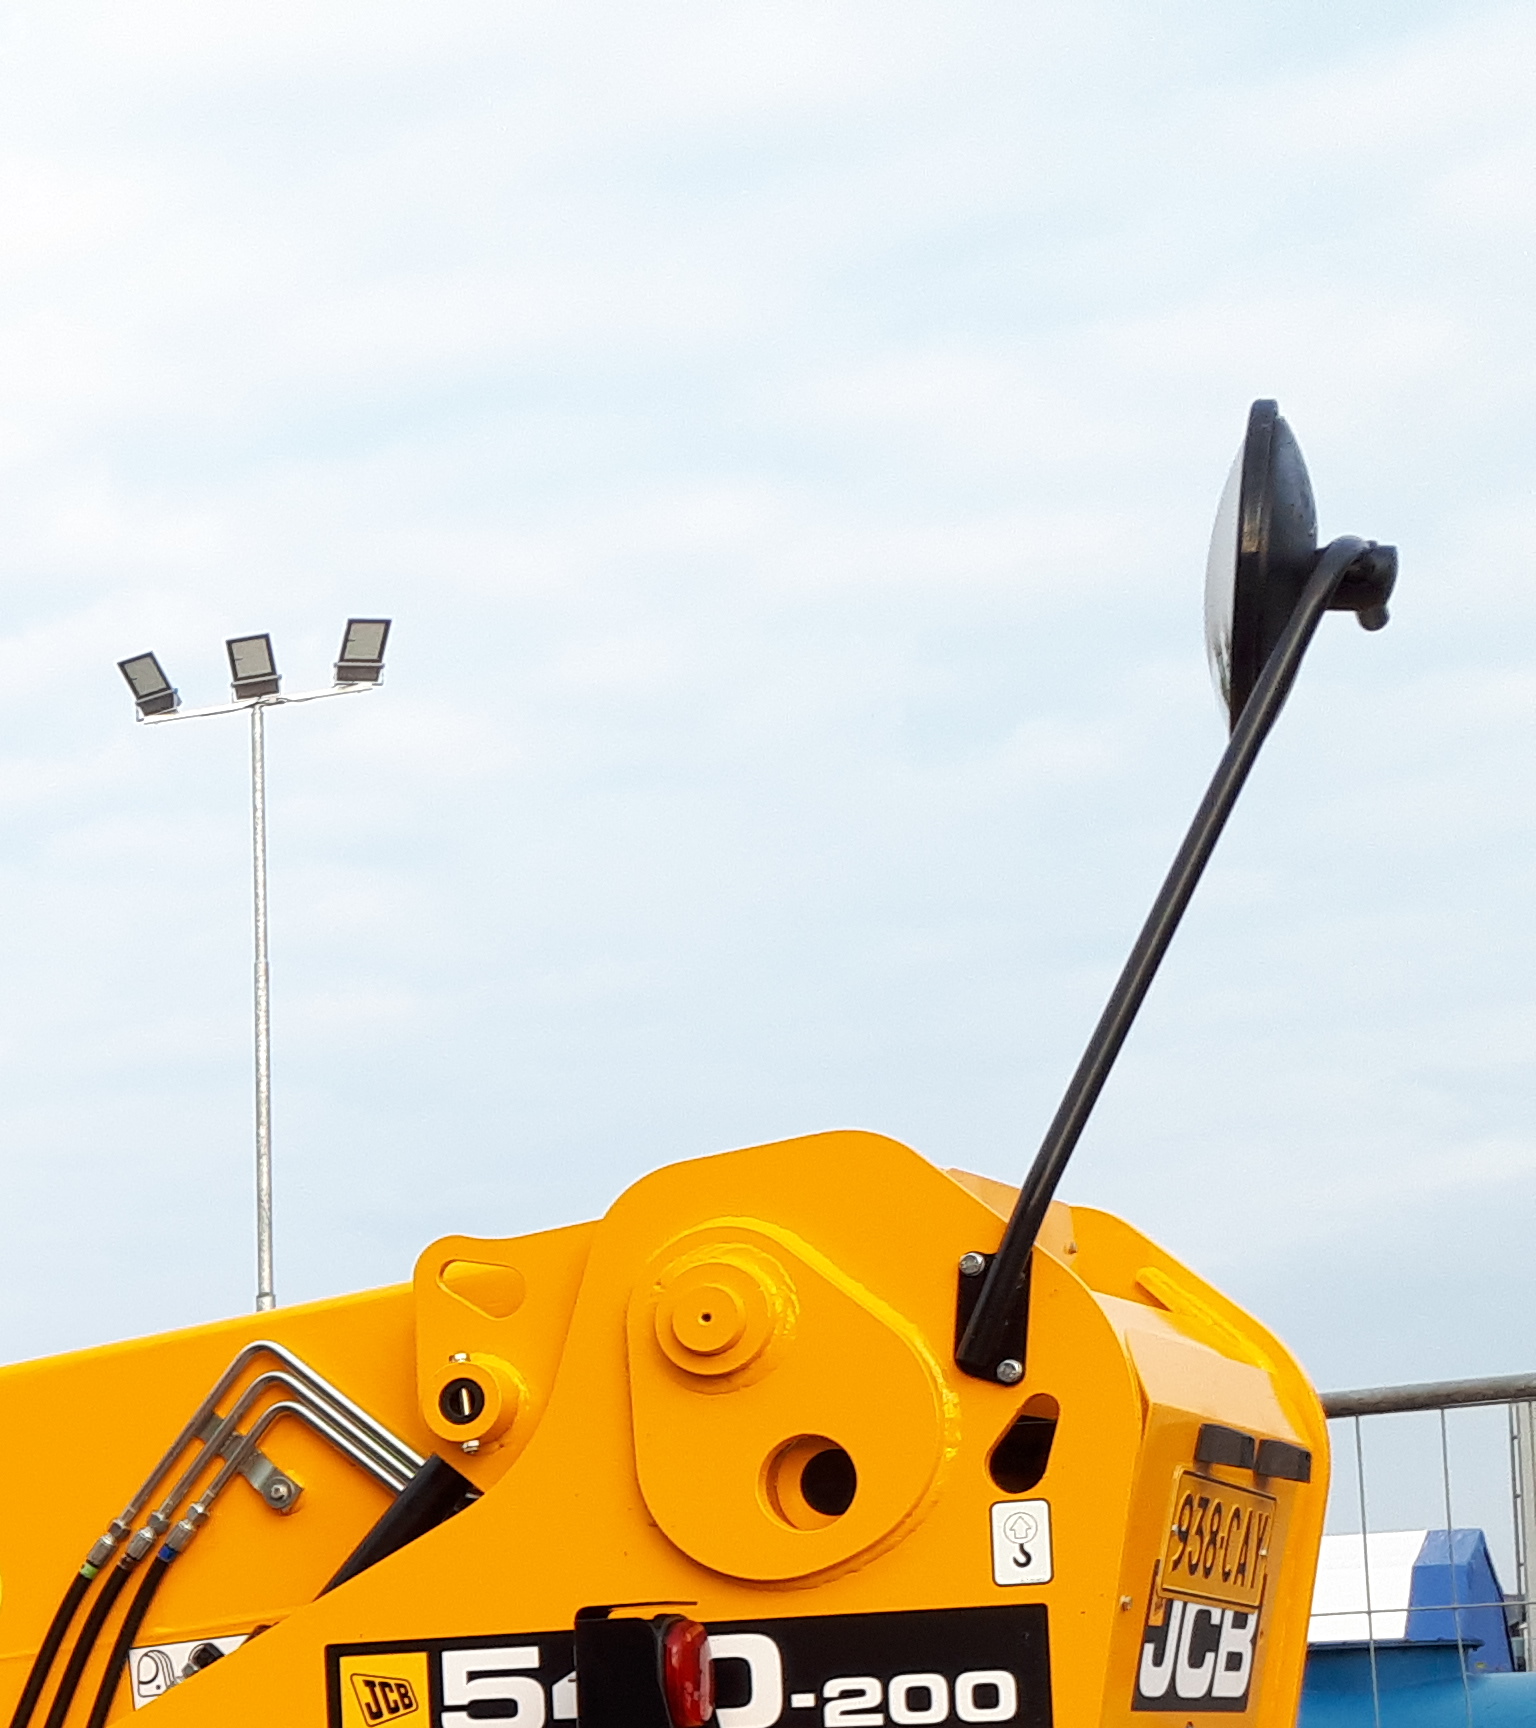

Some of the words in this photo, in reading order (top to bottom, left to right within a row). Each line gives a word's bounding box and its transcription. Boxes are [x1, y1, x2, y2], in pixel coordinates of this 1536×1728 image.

[1170, 1492, 1269, 1589] 938-CAY
[1139, 1600, 1258, 1698] JCB
[362, 1679, 413, 1721] JCB
